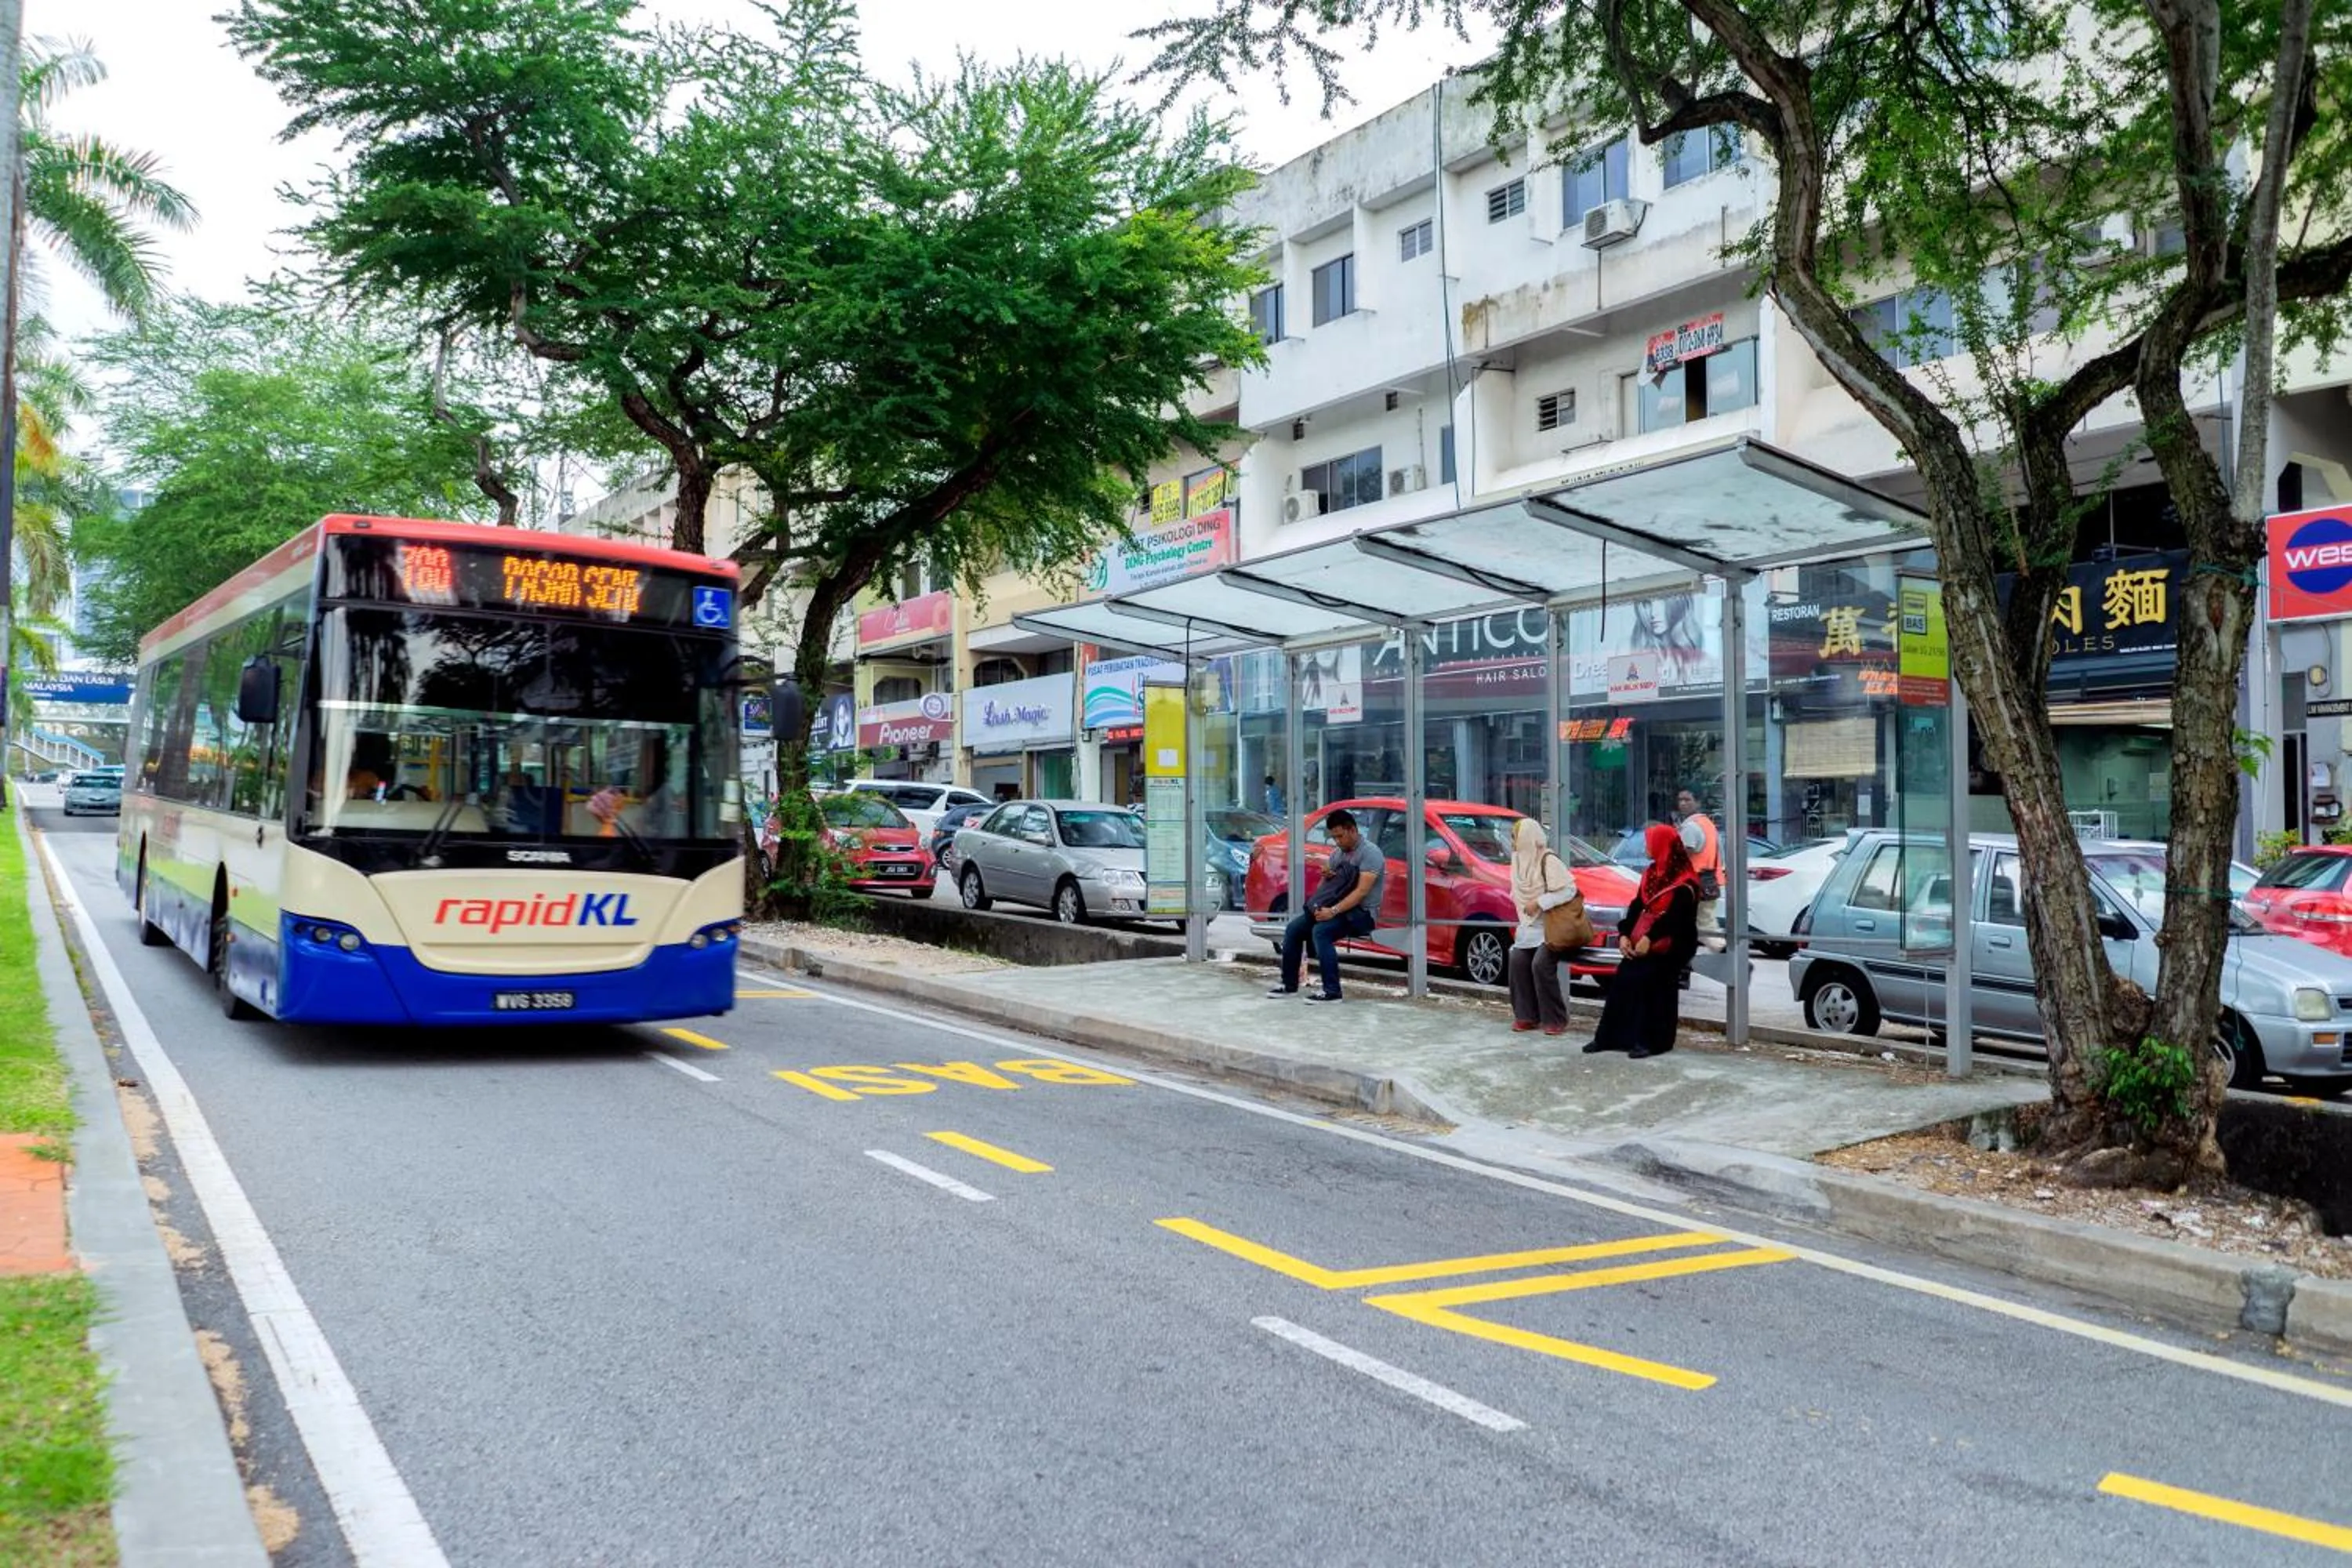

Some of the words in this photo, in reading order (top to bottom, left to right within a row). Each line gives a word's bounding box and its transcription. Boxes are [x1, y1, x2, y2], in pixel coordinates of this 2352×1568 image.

[1147, 524, 1196, 548] PSIKOLOGI
[1197, 519, 1221, 535] DING
[1145, 545, 1186, 564] Psychology
[1187, 539, 1214, 554] Centre
[503, 555, 582, 607] PASAR
[584, 565, 640, 613] SENI
[1771, 604, 1820, 622] RESTORAN
[1906, 616, 1924, 630] BAS
[60, 675, 82, 684] DAN
[1476, 670, 1506, 684] HAIR
[1512, 666, 1548, 681] SALO
[23, 681, 74, 692] MALAYSIA
[983, 700, 1011, 728] Lash
[1016, 704, 1051, 726] Magic
[879, 723, 935, 745] Pioneer
[506, 850, 572, 863] SCANIA
[434, 892, 641, 935] rapidKL
[808, 1058, 1139, 1095] BAS
